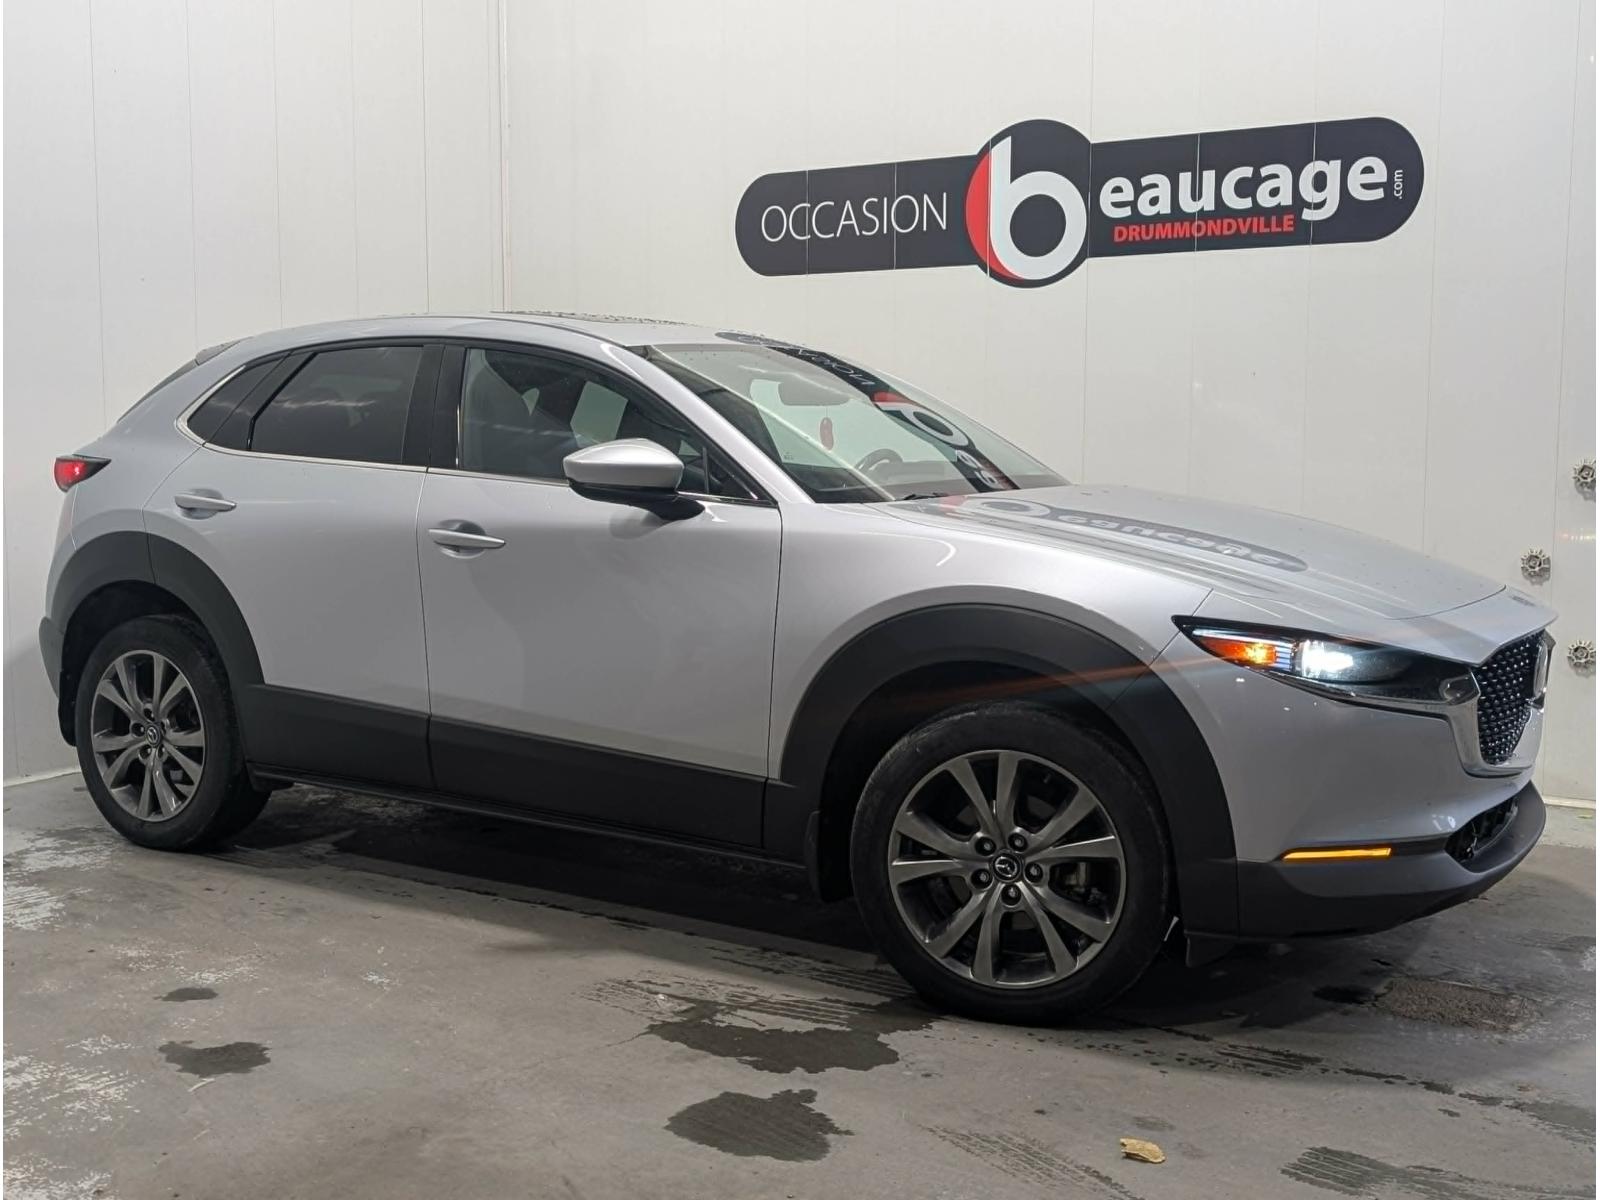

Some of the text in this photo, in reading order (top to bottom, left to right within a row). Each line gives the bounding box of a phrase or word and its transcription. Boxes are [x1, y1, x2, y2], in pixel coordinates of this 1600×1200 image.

[761, 192, 947, 242] OCCASION
[1393, 169, 1403, 200] .com
[1113, 214, 1295, 242] DRUMMONDVILLE
